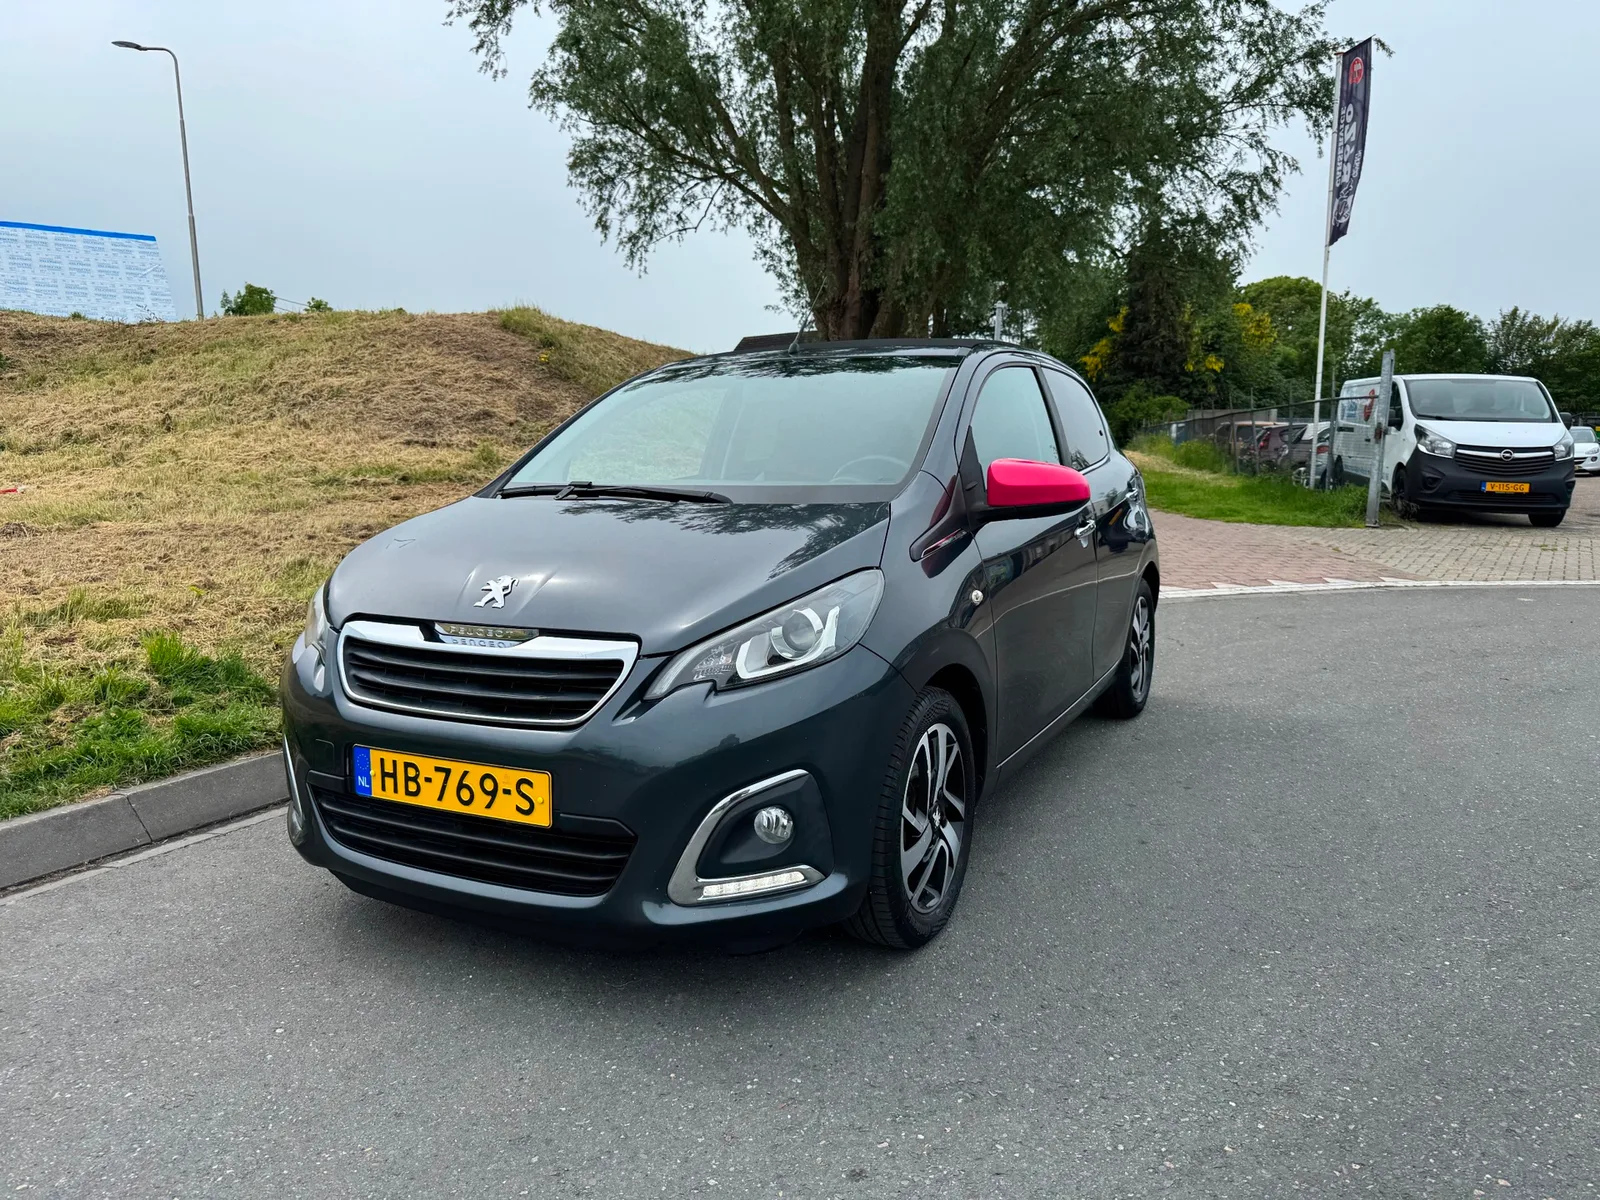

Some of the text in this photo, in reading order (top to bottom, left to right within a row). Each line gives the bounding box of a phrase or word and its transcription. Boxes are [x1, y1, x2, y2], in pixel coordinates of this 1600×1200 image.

[448, 626, 514, 638] PEUGEOT
[358, 757, 535, 816] NL HB-769-S
